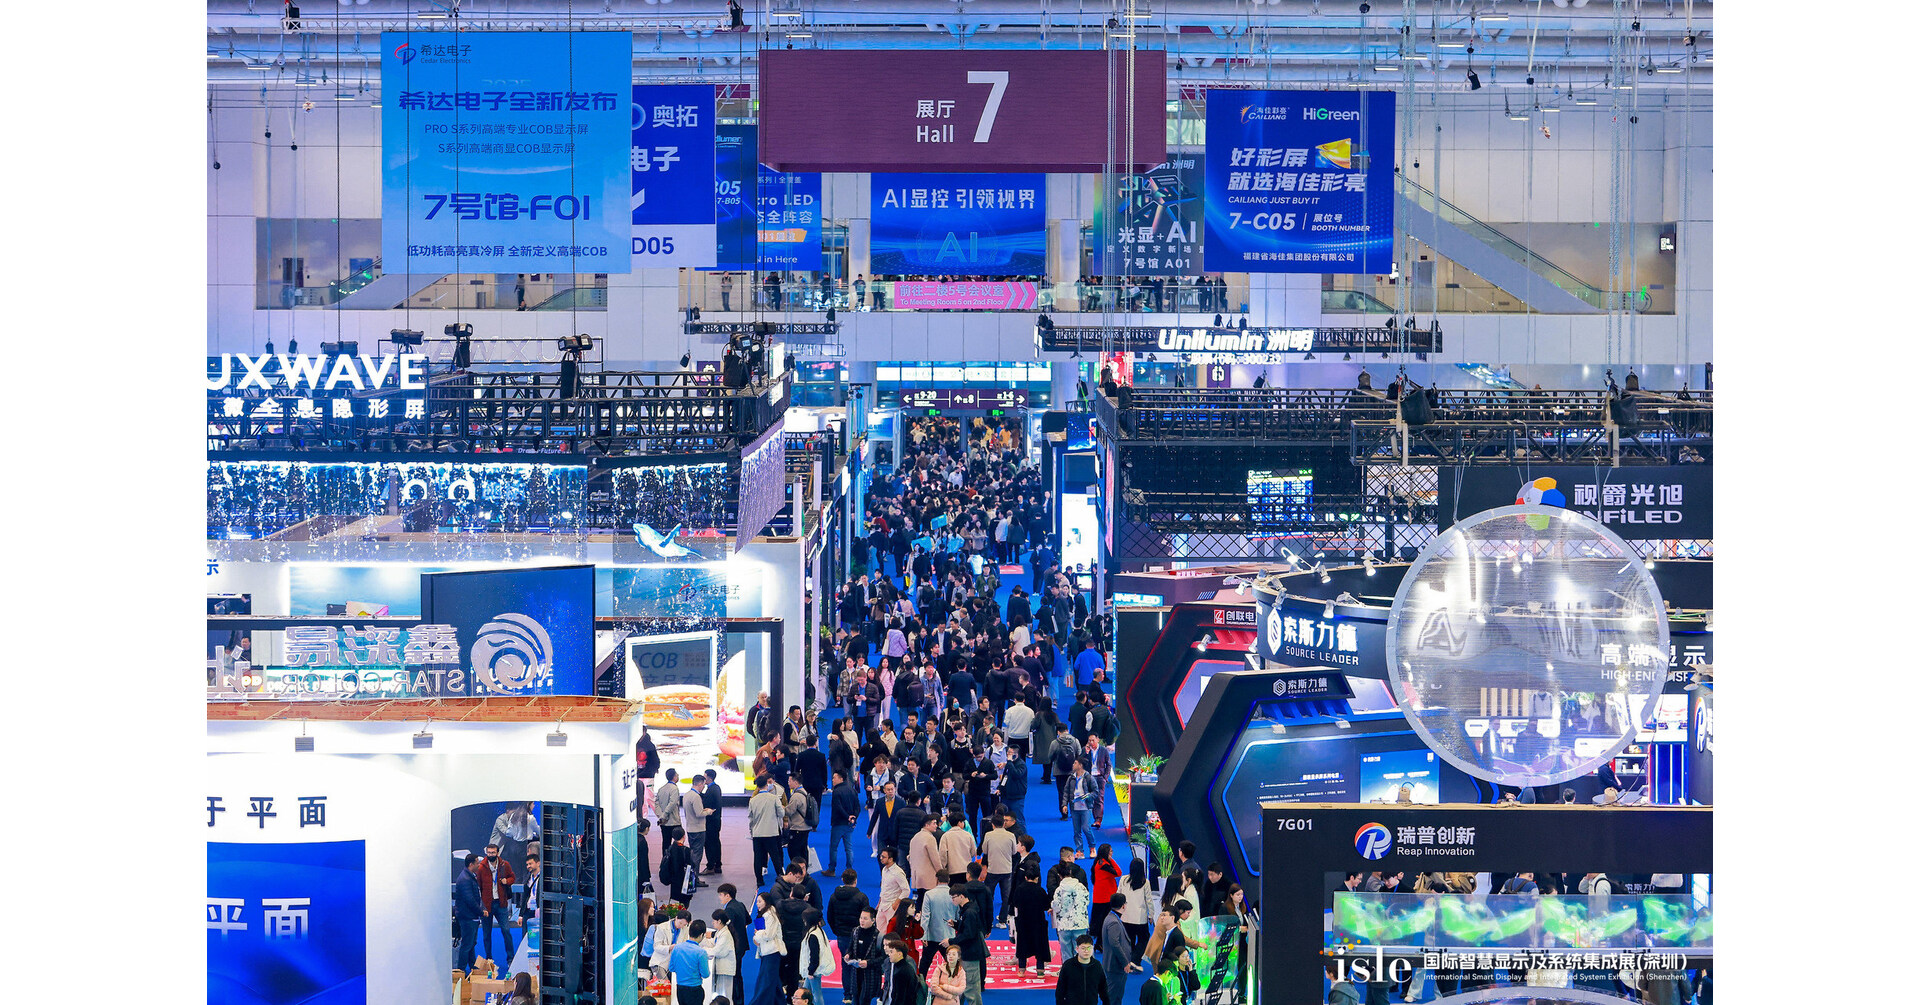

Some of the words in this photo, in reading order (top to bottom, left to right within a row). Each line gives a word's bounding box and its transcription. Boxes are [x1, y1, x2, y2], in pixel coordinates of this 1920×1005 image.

[420, 44, 472, 57] 希达电子
[399, 91, 618, 111] 希达电子全新发布
[916, 99, 955, 119] 展厅
[967, 70, 1010, 143] 7
[652, 104, 698, 128] 奥拓
[1248, 112, 1287, 120] CAILIANG
[1303, 107, 1360, 121] HiGreen
[424, 124, 448, 135] PRO
[451, 123, 589, 136] S系列高端专业COB显示屏
[916, 124, 954, 143] Hall
[438, 143, 576, 154] S系列高端商显COB显示屏
[632, 146, 681, 172] 电子
[1229, 147, 1309, 167] 好彩屏
[1227, 172, 1367, 192] 就选海佳彩亮
[784, 194, 814, 206] LED
[882, 188, 949, 209] AI显控
[956, 188, 1035, 210] 引领视界
[1228, 196, 1268, 204] CAILIANG
[1269, 196, 1290, 204] JUST
[1229, 212, 1296, 231] 7-C05
[1313, 214, 1343, 223] 展位号
[1311, 224, 1336, 232] BOOTH
[408, 245, 505, 257] 低功耗高亮真冷屏
[508, 245, 608, 257] 全新定义高端COB
[1243, 252, 1355, 262] 福建省海佳集团股份有限公司
[1164, 258, 1190, 269] A01
[900, 284, 1004, 297] 前往二楼5号会议室
[1158, 329, 1264, 351] Unilumin
[1267, 329, 1314, 351] 洲明
[223, 397, 425, 420] 微全息隐形屏
[1574, 484, 1682, 506] 视爵光旭
[1285, 645, 1315, 660] SOURCE
[1319, 651, 1359, 666] LEADER
[1277, 819, 1313, 831] 7G01
[1397, 826, 1476, 845] 瑞普创新
[1397, 847, 1423, 857] Reap
[1425, 847, 1475, 856] Innovation
